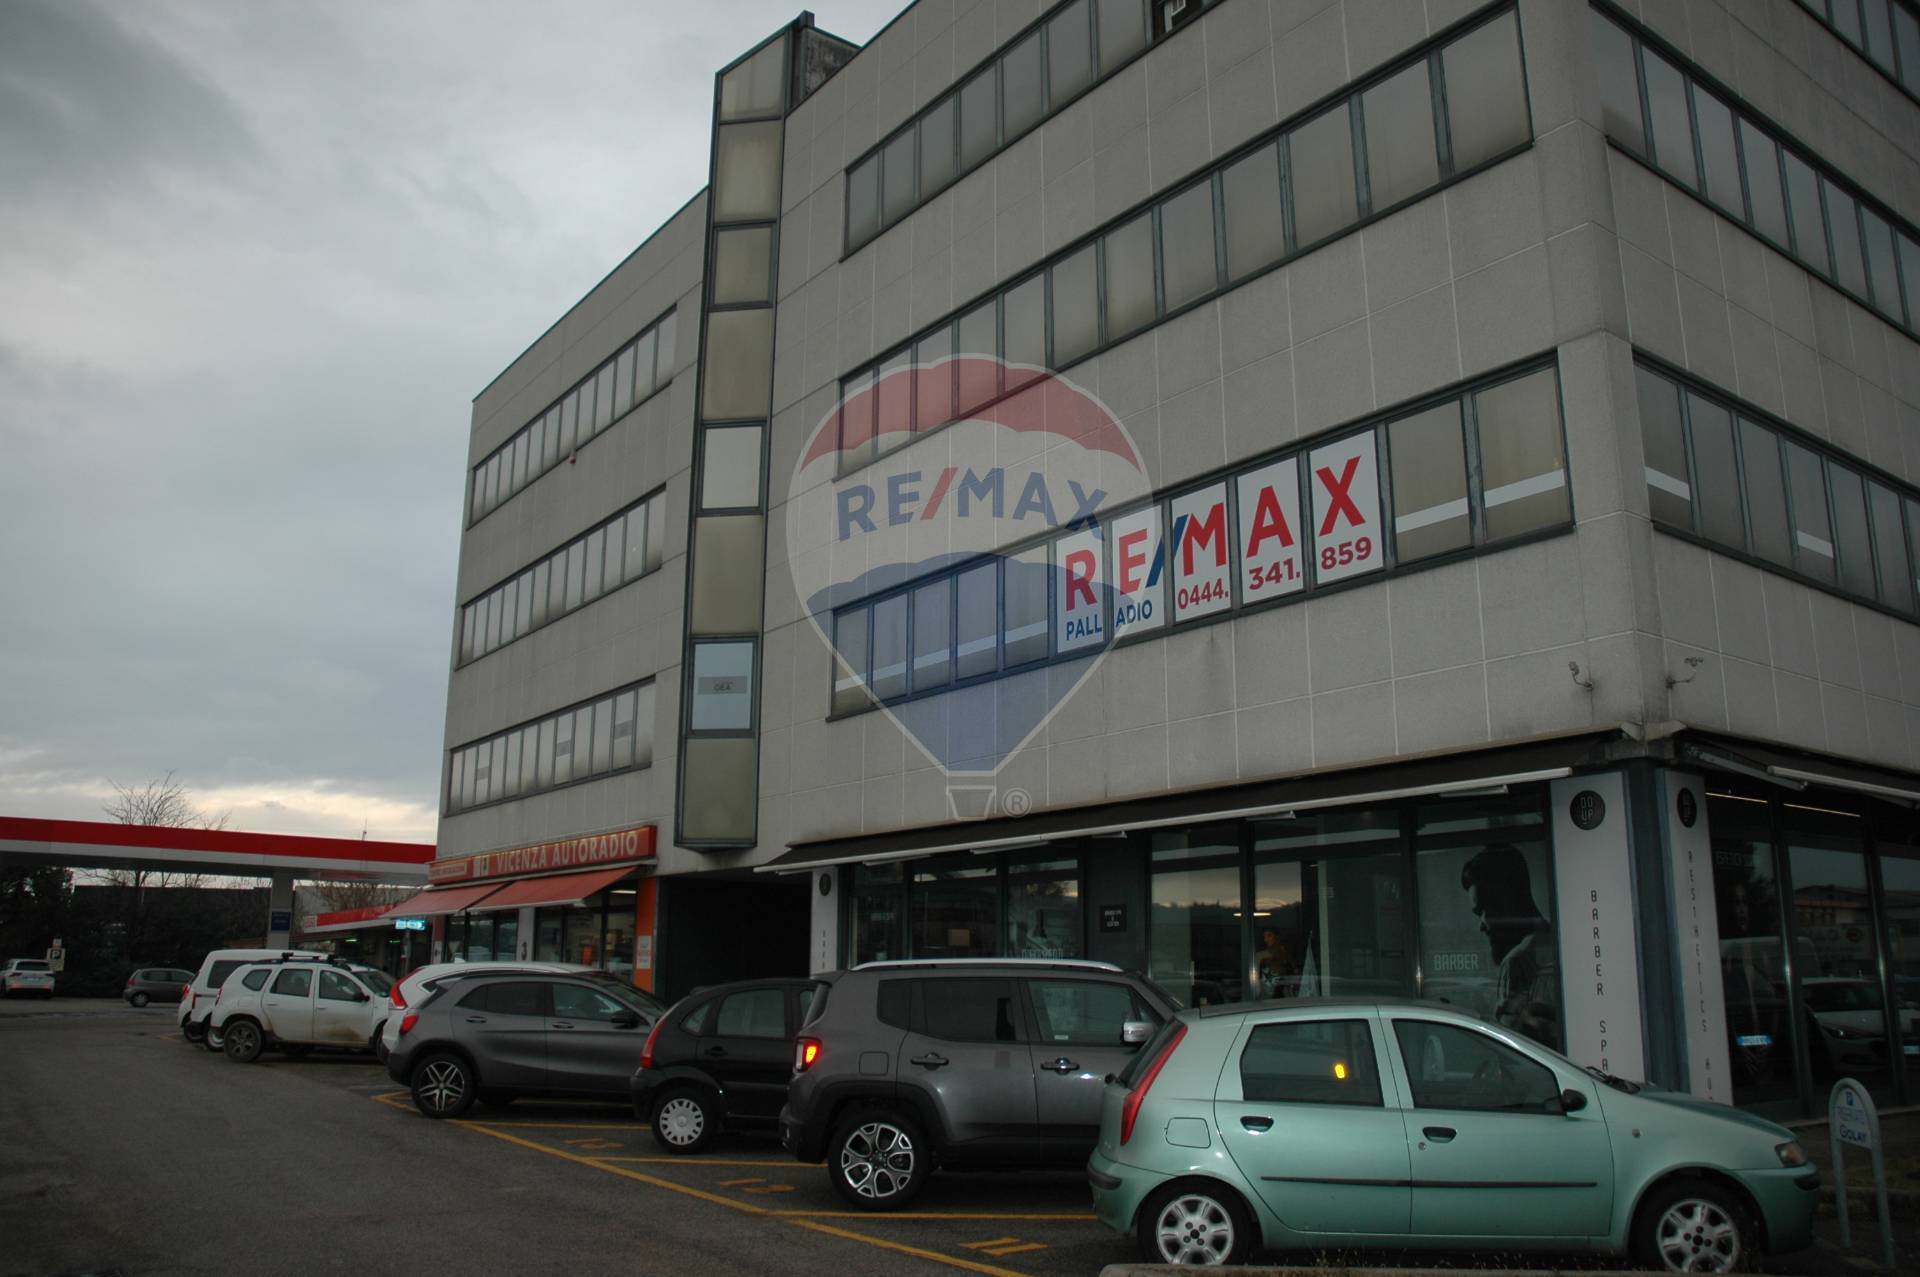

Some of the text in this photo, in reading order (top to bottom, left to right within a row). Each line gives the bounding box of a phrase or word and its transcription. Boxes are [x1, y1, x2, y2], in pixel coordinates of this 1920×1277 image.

[1065, 455, 1366, 612] RE/MAX
[1177, 536, 1372, 610] 0444. 341. 859
[496, 845, 548, 874] VICENZA
[552, 830, 639, 867] AUTORADIO
[1433, 952, 1480, 971] BARBER
[1591, 889, 1608, 1072] BARBER SPA
